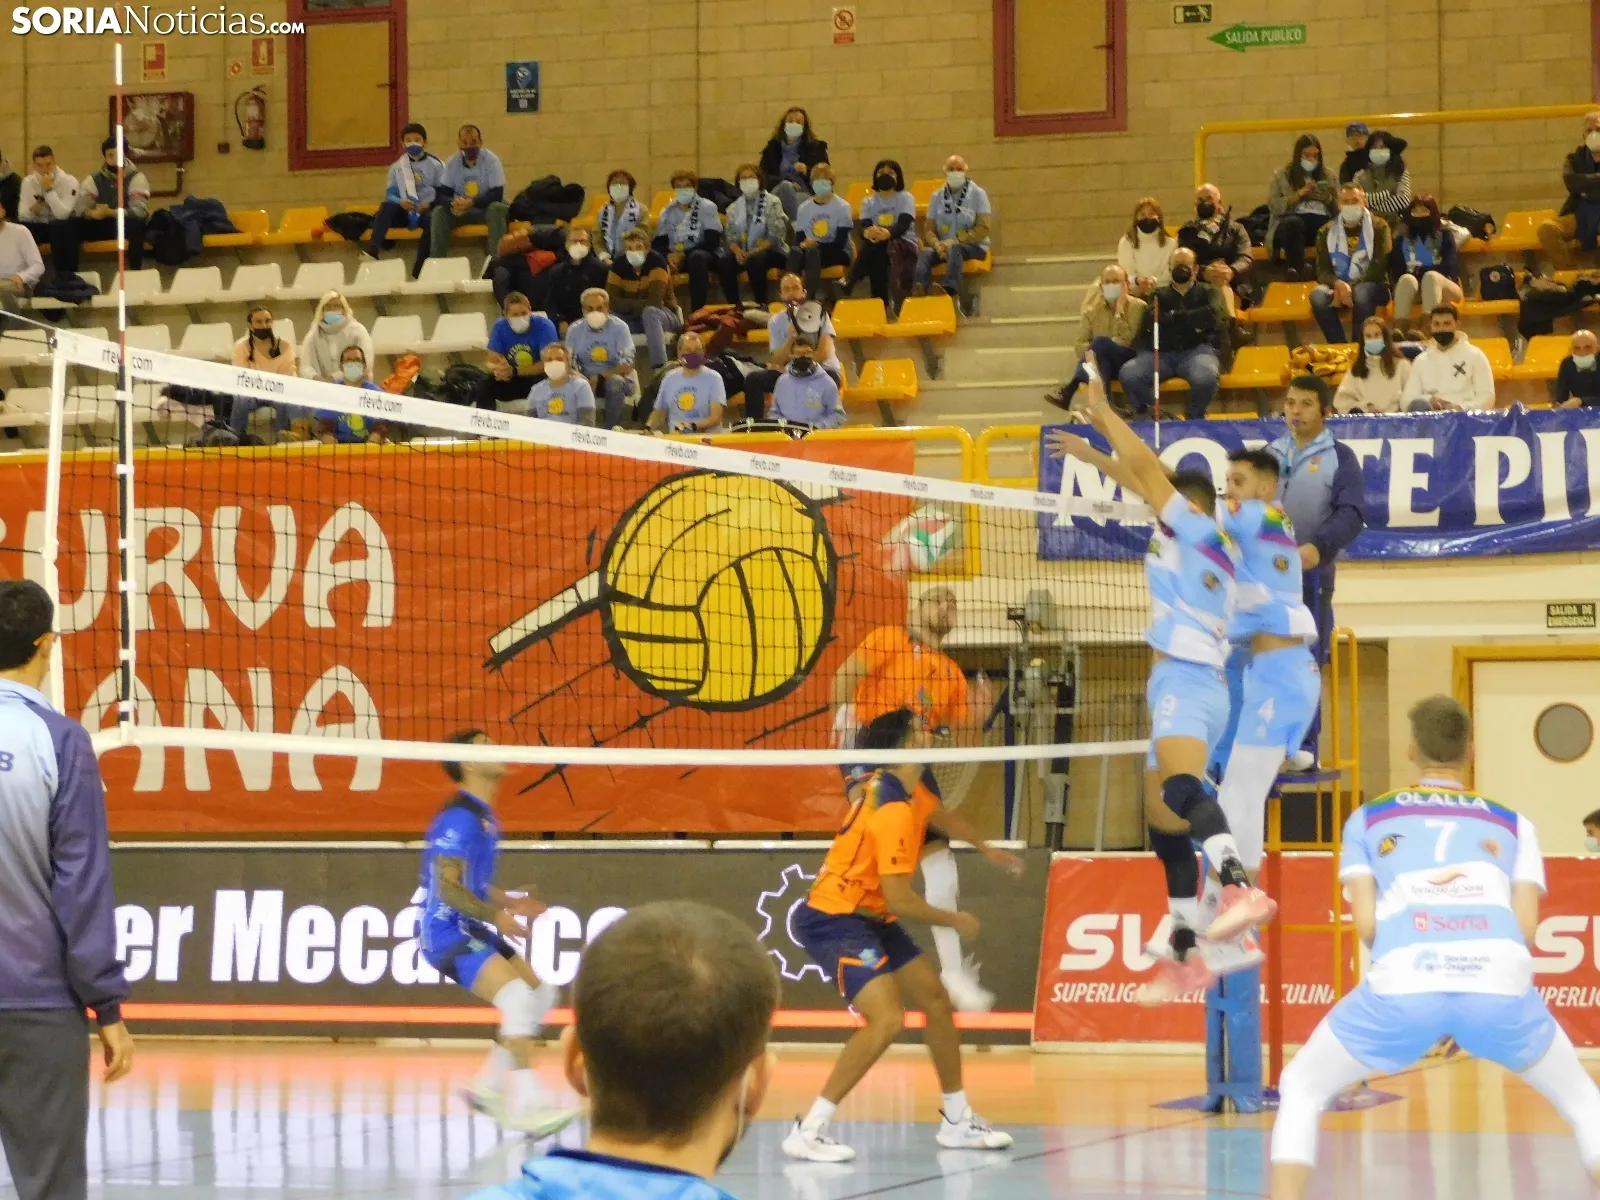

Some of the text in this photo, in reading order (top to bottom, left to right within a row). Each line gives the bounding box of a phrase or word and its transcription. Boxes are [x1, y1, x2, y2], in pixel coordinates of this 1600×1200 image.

[1225, 30, 1259, 44] SALIDA
[236, 373, 284, 394] rfevb.com
[359, 392, 403, 414] rfevb.com
[470, 411, 509, 432] rfevb.com
[571, 427, 608, 448] rfevb.com
[664, 443, 698, 461] rfevb.com
[1053, 433, 1440, 528] MOTE
[0, 501, 395, 635] URVA
[1549, 604, 1593, 616] SALIDA DE
[1257, 697, 1275, 725] 4
[1395, 791, 1491, 813] OLALLA
[1424, 818, 1460, 862] 7
